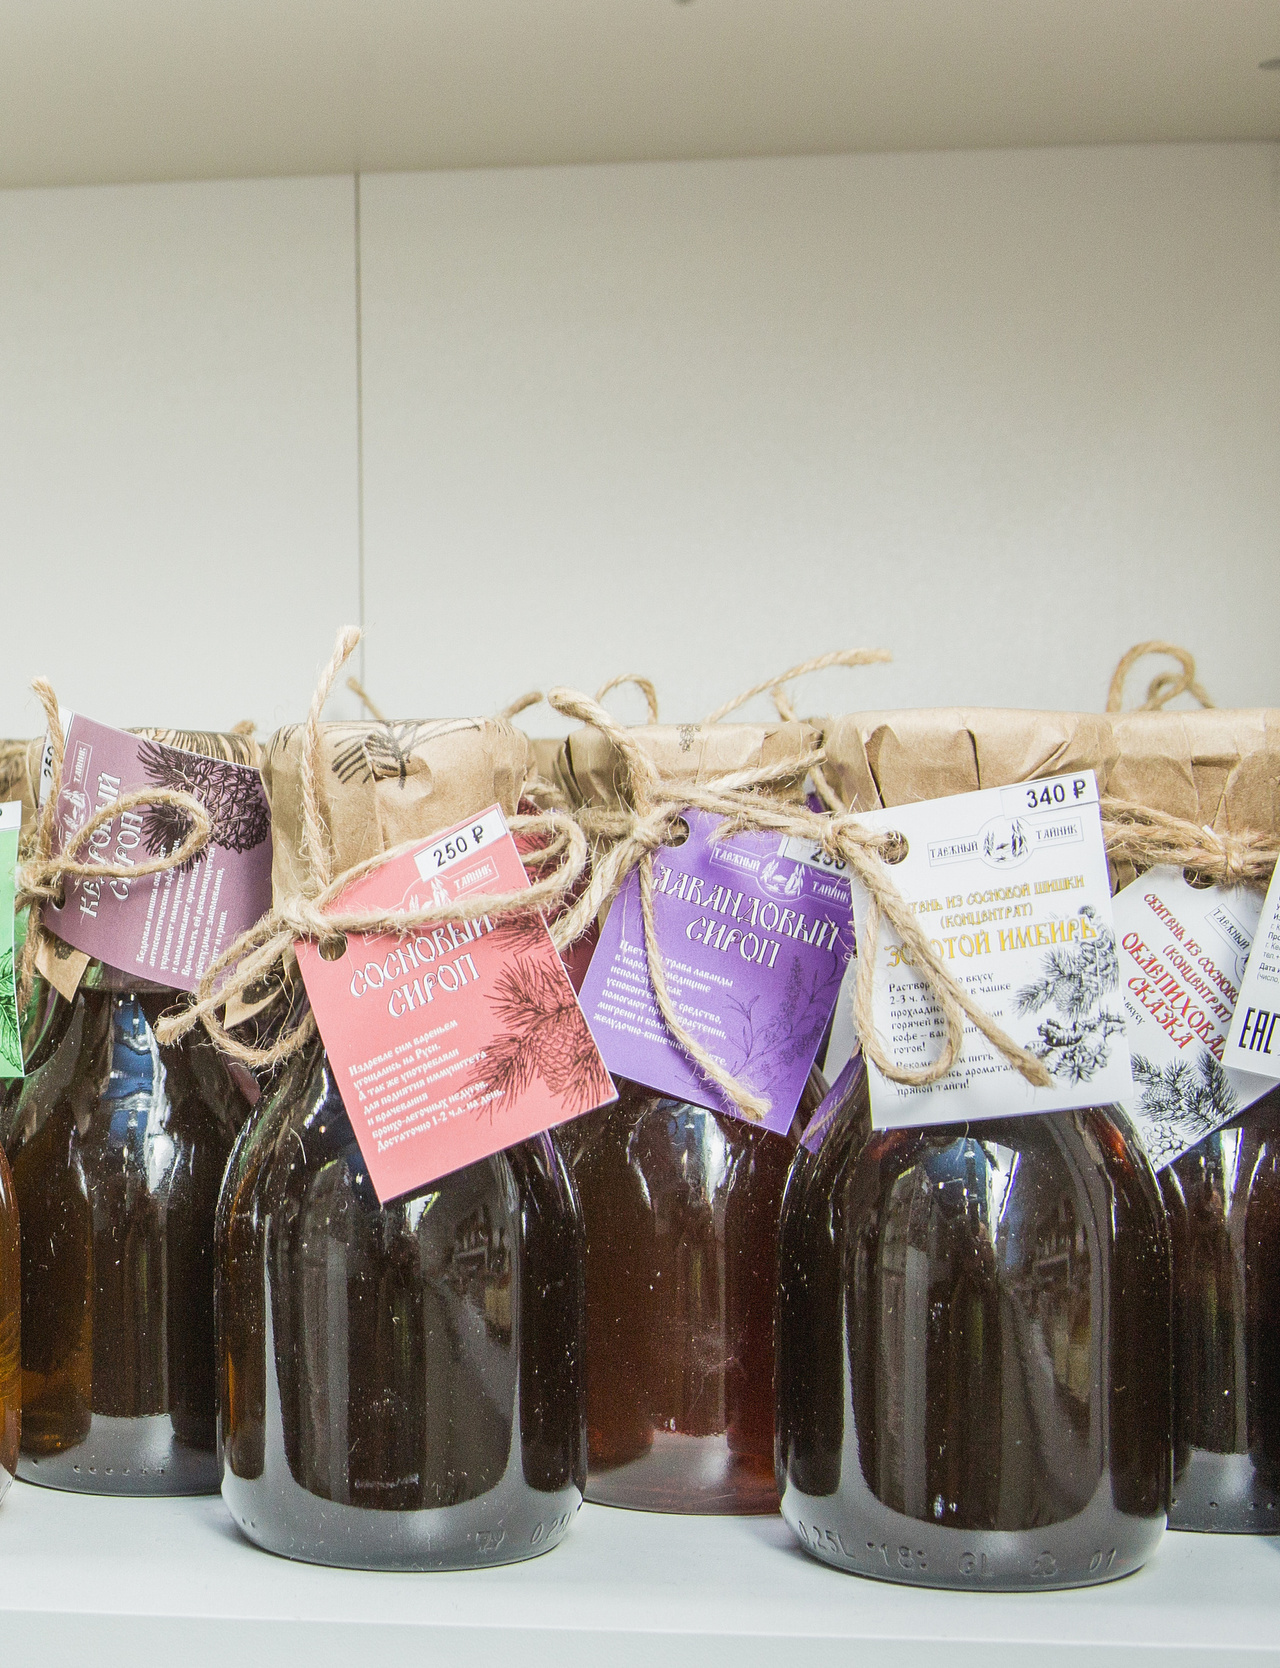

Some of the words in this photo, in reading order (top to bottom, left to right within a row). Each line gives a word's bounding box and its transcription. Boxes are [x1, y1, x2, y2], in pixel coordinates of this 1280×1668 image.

[1026, 784, 1065, 808] 340
[80, 771, 121, 917] КЕРОЫЙ
[433, 836, 468, 867] 250
[930, 841, 978, 858] ТАЕЖНЫЙ
[1036, 824, 1077, 839] ТАЙНИК
[196, 846, 216, 915] рекомендуется
[206, 867, 225, 926] заболевания,
[945, 894, 963, 909] ИЗ
[966, 883, 1031, 905] СОСНОВОЙ
[1034, 875, 1084, 895] ШИШКИ
[135, 920, 151, 963] Кедровая
[146, 888, 158, 920] шишка
[159, 923, 174, 970] укрепляет
[169, 870, 185, 923] иммунитет
[193, 915, 201, 928] ей
[651, 865, 841, 952] ЛАВАНДОВЫЙ
[940, 902, 1033, 929] (КОНЦЕНТРАТ)
[149, 889, 170, 967] антисептическим
[686, 917, 782, 968] СИРОП
[997, 914, 1098, 951] ИМБИРЬ
[1213, 908, 1250, 950] ТАЕЖНЫЙ
[180, 929, 199, 977] Врачевать
[1143, 893, 1185, 941] СБИТЕНЬ
[1183, 938, 1202, 956] ИЗ
[1197, 957, 1239, 1007] СОСНОВО
[1258, 962, 1276, 972] Дата
[387, 953, 480, 1018] СИРОП
[666, 958, 692, 973] трава
[693, 968, 733, 987] лаванды
[966, 973, 993, 983] вкусу
[1162, 944, 1234, 1025] (КОНЦЕНТРАТ)
[597, 1001, 636, 1020] мигрени
[602, 989, 647, 1010] помогают
[890, 994, 906, 1005] 2-3
[979, 984, 1010, 993] чашке
[678, 1003, 722, 1024] средство,
[891, 1017, 931, 1031] горячей
[1124, 1001, 1145, 1025] вкусу
[1127, 977, 1194, 1049] СКАЗКА
[348, 1050, 393, 1077] Издревле
[394, 1041, 413, 1055] сим
[413, 1019, 458, 1046] вареньем
[892, 1032, 917, 1043] кофе
[893, 1041, 926, 1054] готов!
[353, 1062, 402, 1091] угощались
[402, 1055, 415, 1065] на
[414, 1043, 441, 1059] Руси.
[358, 1090, 367, 1101] А
[366, 1083, 386, 1096] так
[385, 1076, 399, 1088] же
[400, 1048, 459, 1083] употребляли
[968, 1054, 994, 1062] пить
[363, 1100, 380, 1115] для
[380, 1079, 425, 1105] поднятия
[426, 1051, 487, 1084] иммунитета
[935, 1078, 969, 1091] тайги!
[367, 1117, 374, 1126] и
[375, 1092, 428, 1122] врачевания
[377, 1121, 431, 1153] Достаточно
[431, 1111, 448, 1126] 1-2
[466, 1099, 479, 1110] на
[480, 1085, 505, 1105] день.
